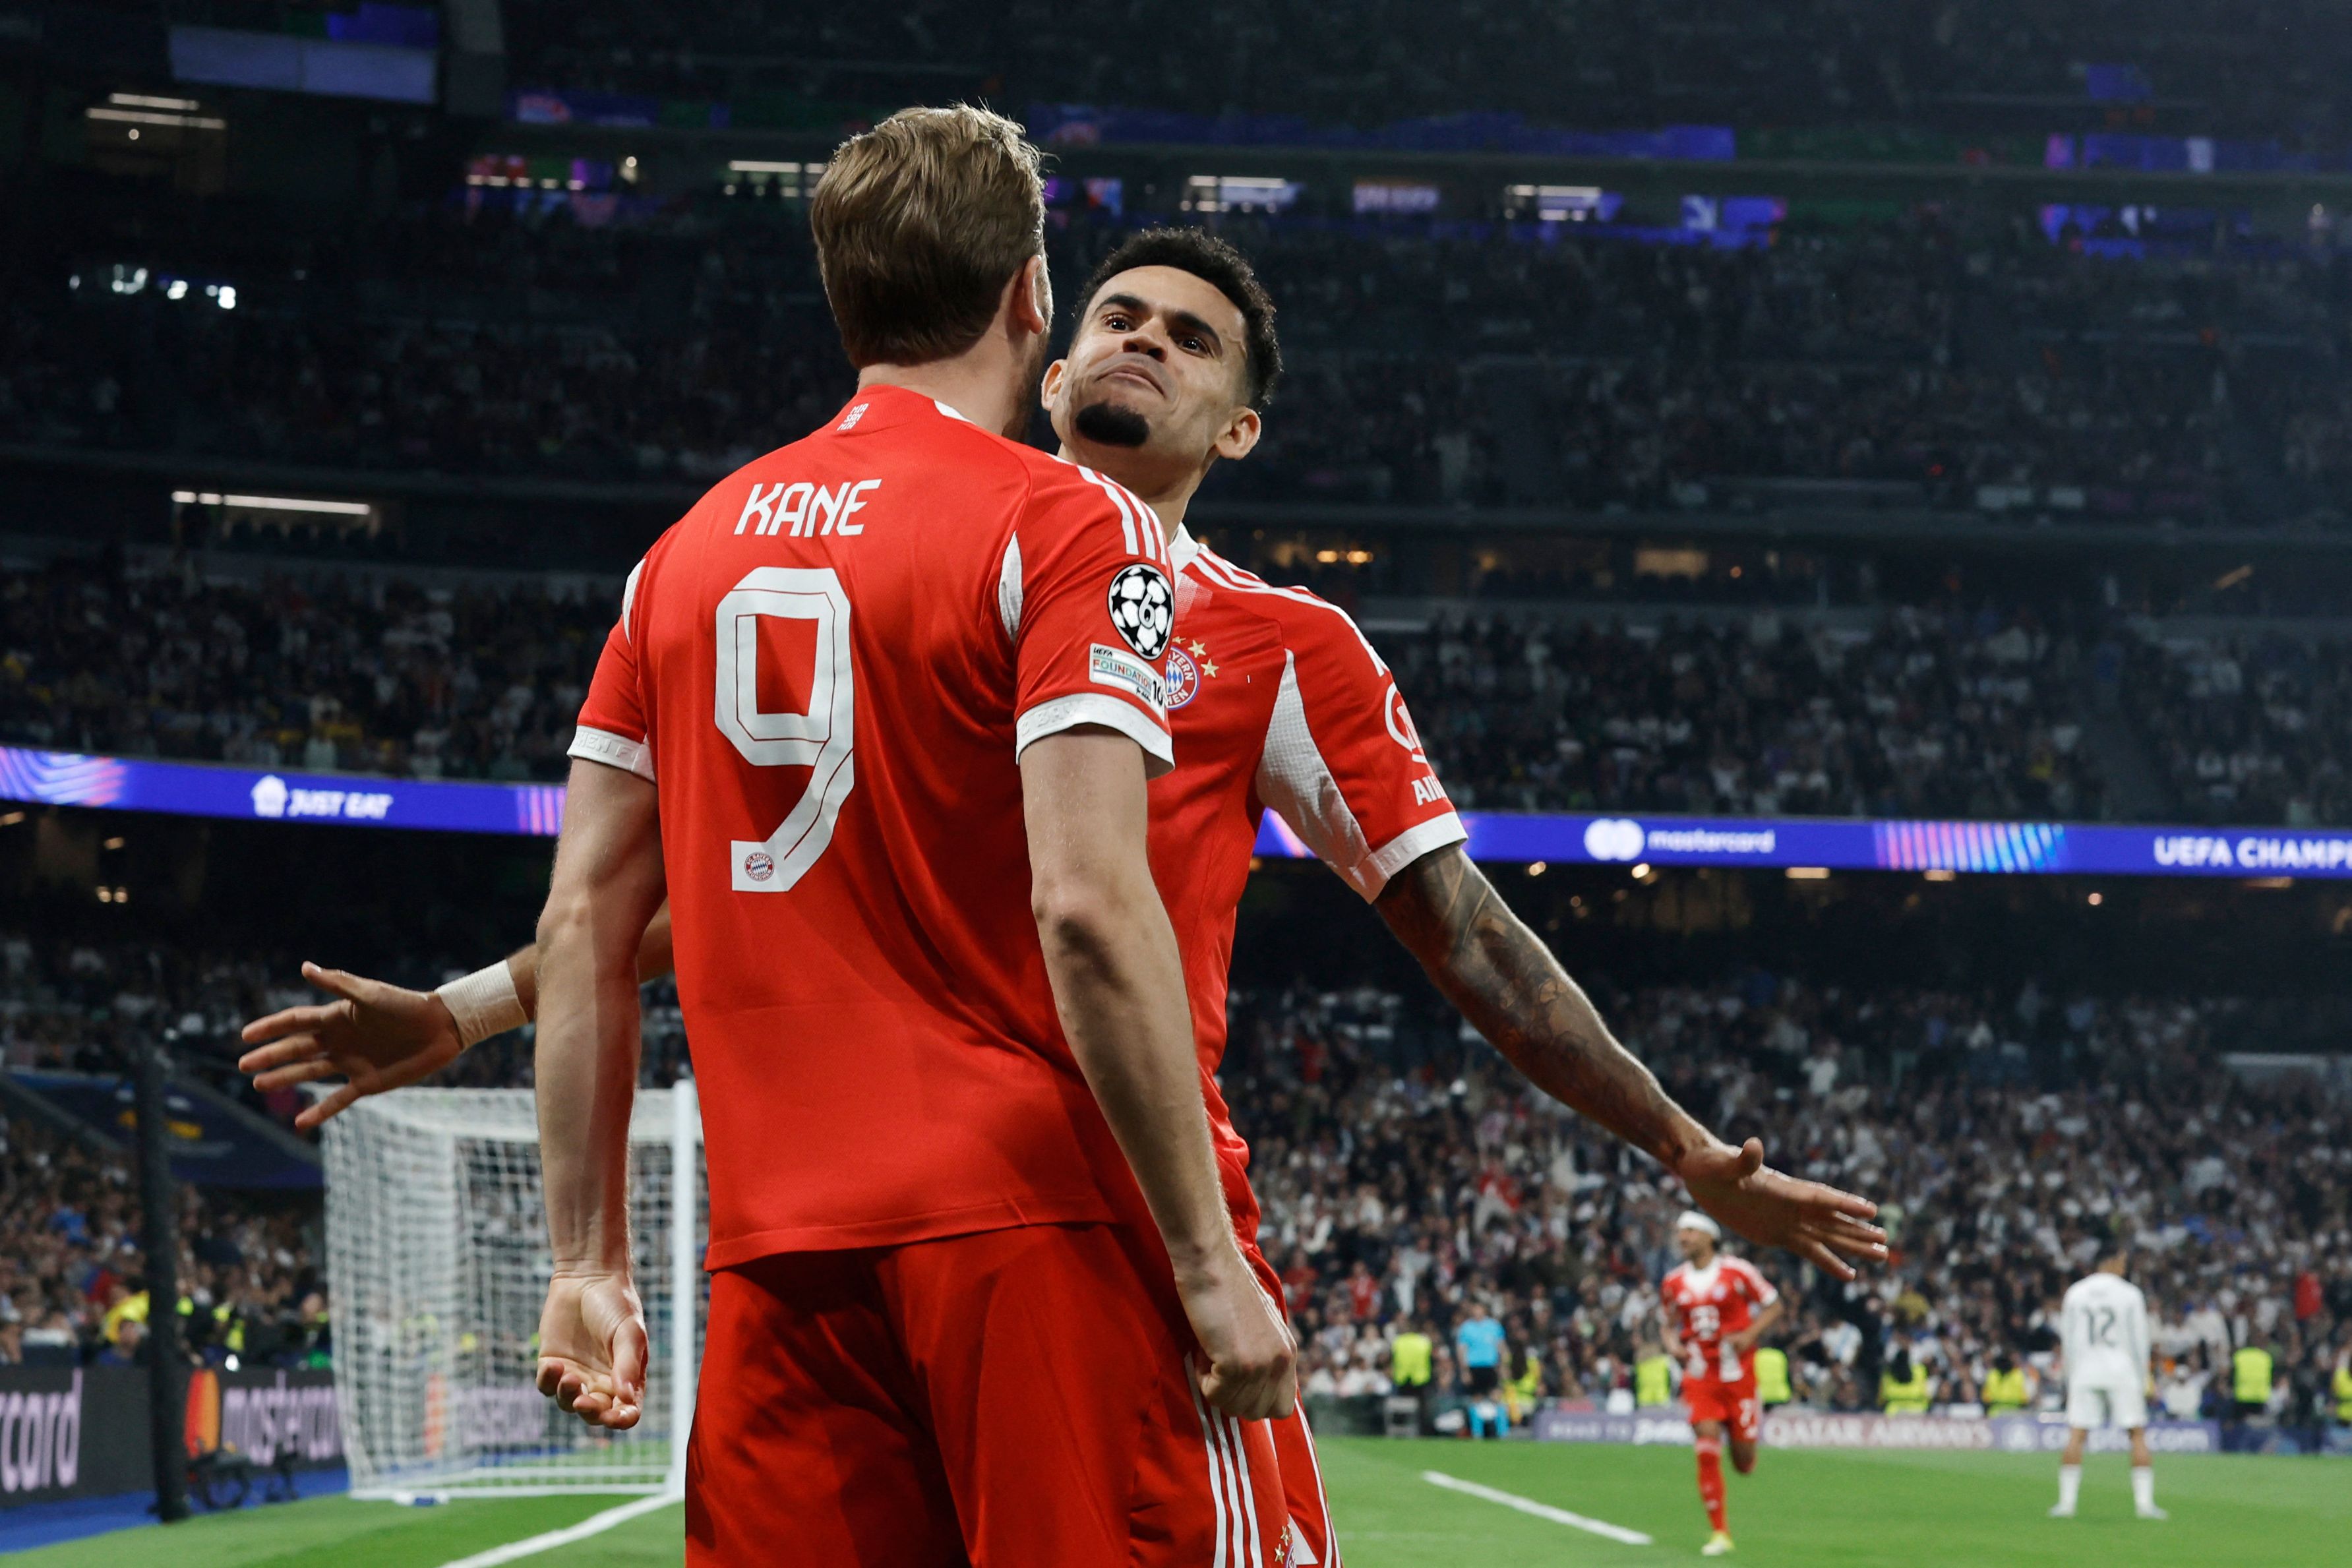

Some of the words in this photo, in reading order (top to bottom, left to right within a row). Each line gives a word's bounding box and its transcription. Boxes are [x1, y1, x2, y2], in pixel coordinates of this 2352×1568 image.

[734, 479, 882, 537] KANE
[1138, 593, 1156, 629] 6
[1093, 647, 1113, 657] UEFA
[1093, 658, 1152, 691] FOUNDATION
[715, 566, 855, 893] 9
[287, 788, 346, 817] JUST
[344, 791, 394, 819] EAT
[1411, 775, 1447, 806] Alli
[1647, 828, 1776, 854] mastercard
[2153, 835, 2235, 867] UEFA
[2082, 1305, 2117, 1346] 12
